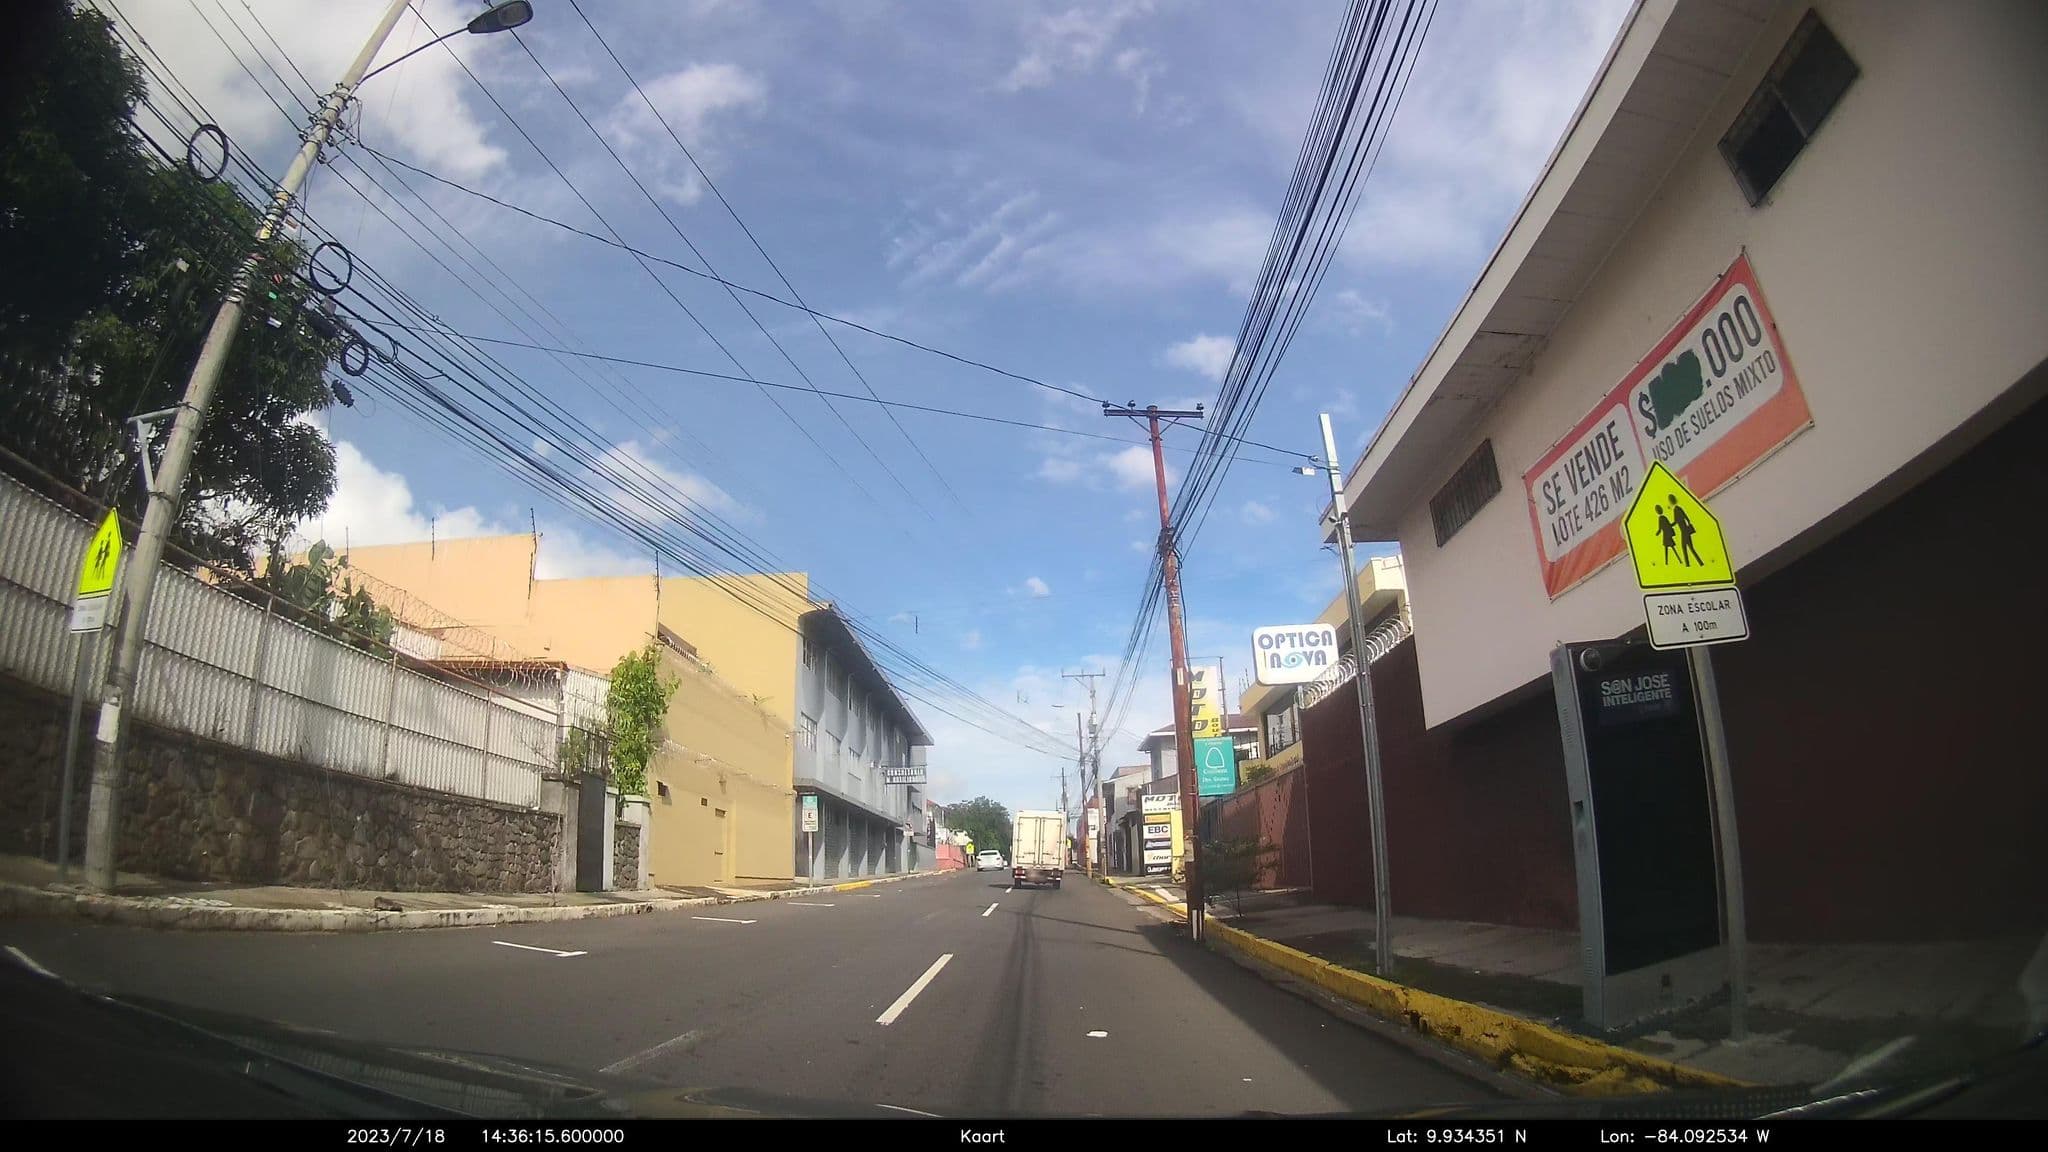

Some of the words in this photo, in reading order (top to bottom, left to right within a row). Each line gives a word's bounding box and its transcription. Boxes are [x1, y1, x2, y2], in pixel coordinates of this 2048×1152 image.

[1651, 440, 1675, 464] USO
[1673, 424, 1692, 450] DE
[1689, 385, 1736, 438] SUELOS
[1735, 349, 1777, 402] MIXTO
[1542, 471, 1566, 515] SE
[1564, 420, 1625, 494] VENDE
[1551, 503, 1583, 546] LOTE
[1583, 491, 1610, 525] 426
[1610, 464, 1634, 504] M2
[1657, 603, 1684, 616] ZONA
[1688, 600, 1731, 613] ESCOLAR
[1681, 623, 1689, 632] A
[1694, 620, 1718, 632] 100m
[1258, 630, 1333, 649] OPTICA
[1270, 650, 1327, 668] NOVA
[1634, 674, 1671, 691] JOSE
[1602, 688, 1673, 707] INTELIGENTE
[1148, 826, 1168, 834] EBC
